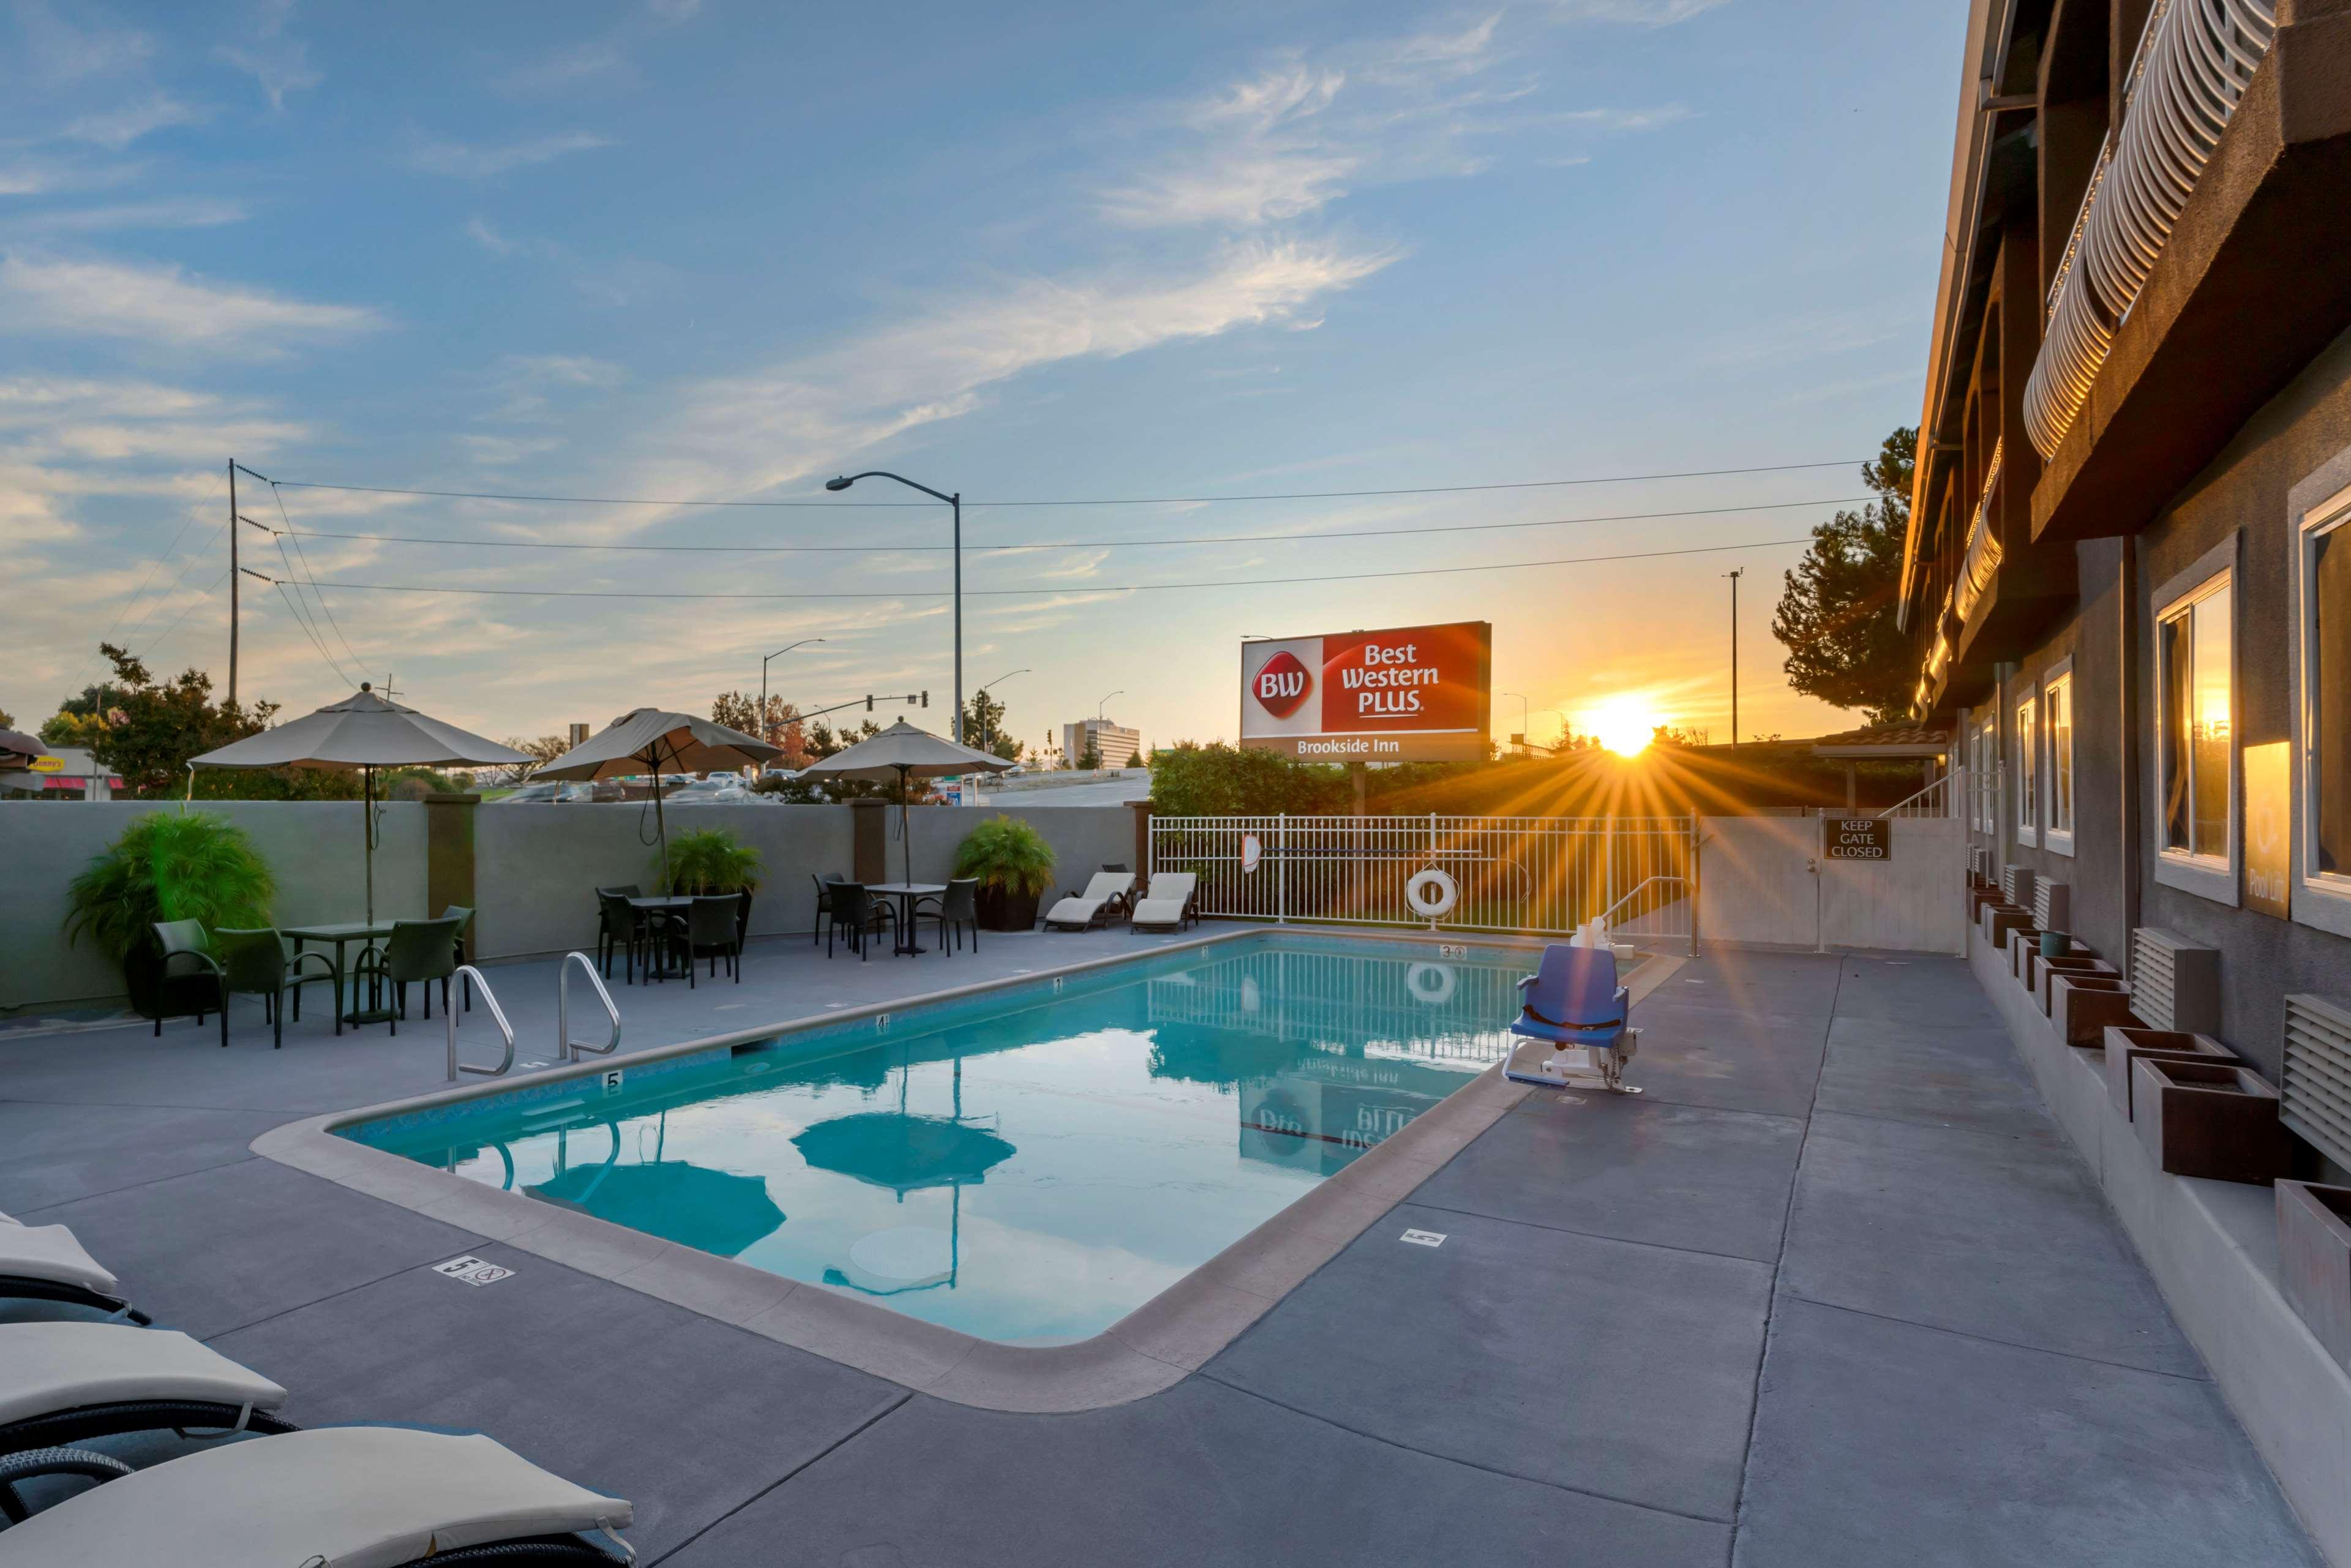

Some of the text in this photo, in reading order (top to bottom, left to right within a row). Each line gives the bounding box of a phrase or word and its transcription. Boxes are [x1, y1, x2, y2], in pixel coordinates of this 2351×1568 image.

[1365, 644, 1417, 666] Best
[1261, 671, 1303, 699] BW
[1342, 667, 1439, 689] Western
[1359, 690, 1420, 713] PLUS
[1298, 739, 1399, 754] Brookside Inn
[1842, 820, 1872, 831] KEEP
[1840, 833, 1874, 844] GATE
[1832, 846, 1883, 857] CLOSED
[2249, 868, 2268, 898] Pool
[608, 1073, 618, 1087] 5
[443, 1259, 479, 1272] 5
